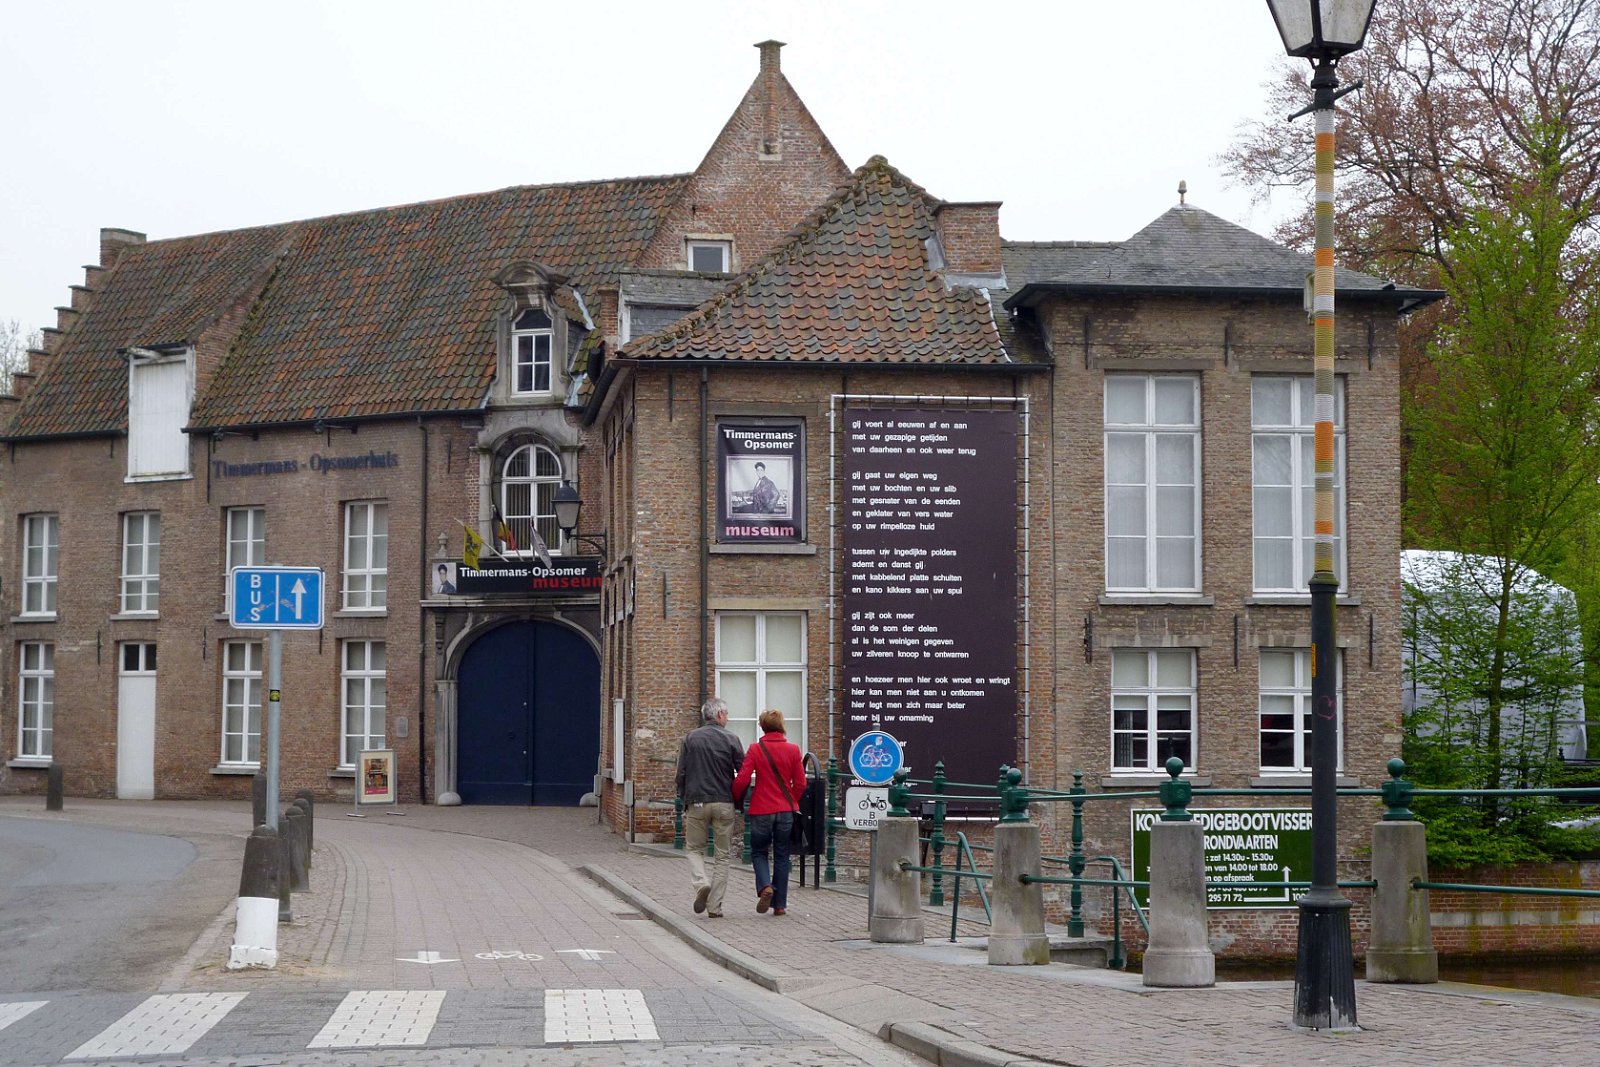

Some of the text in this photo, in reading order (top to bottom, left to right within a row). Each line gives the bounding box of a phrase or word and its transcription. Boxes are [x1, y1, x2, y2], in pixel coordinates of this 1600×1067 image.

[852, 420, 861, 429] gij
[724, 429, 797, 440] Timmermans-
[920, 434, 947, 442] getijden
[744, 440, 794, 450] Opsomer
[958, 448, 976, 456] terug
[212, 459, 298, 479] Timmermans
[309, 450, 398, 475] Opsomerhuis
[852, 471, 860, 480] gij
[865, 472, 881, 480] gaat
[899, 471, 918, 480] eigen
[885, 484, 912, 492] bochten
[870, 497, 900, 505] gesnater
[866, 510, 894, 518] geklater
[881, 522, 916, 531] rimpelloze
[725, 526, 795, 537] museum
[880, 548, 890, 557] uw
[894, 548, 927, 557] ingedijkte
[931, 549, 957, 557] polders
[915, 561, 923, 570] gij
[910, 574, 929, 582] platte
[250, 574, 261, 621] BUS
[852, 612, 860, 620] gij
[865, 612, 875, 620] zijt
[889, 637, 919, 646] weinigen
[898, 651, 919, 659] knoop
[989, 677, 1010, 685] wringt
[870, 701, 882, 709] legt
[872, 714, 880, 722] bij
[899, 714, 933, 723] omarming
[1204, 835, 1278, 850] RONDVAARTEN
[1222, 853, 1245, 861] 14.30u
[1252, 853, 1274, 861] 15.30u
[1229, 864, 1248, 872] 14.00
[1248, 864, 1258, 872] tot
[1260, 864, 1278, 872] 18.00
[1224, 874, 1254, 882] afspraak
[1223, 894, 1230, 902] 71
[1234, 894, 1242, 902] 72
